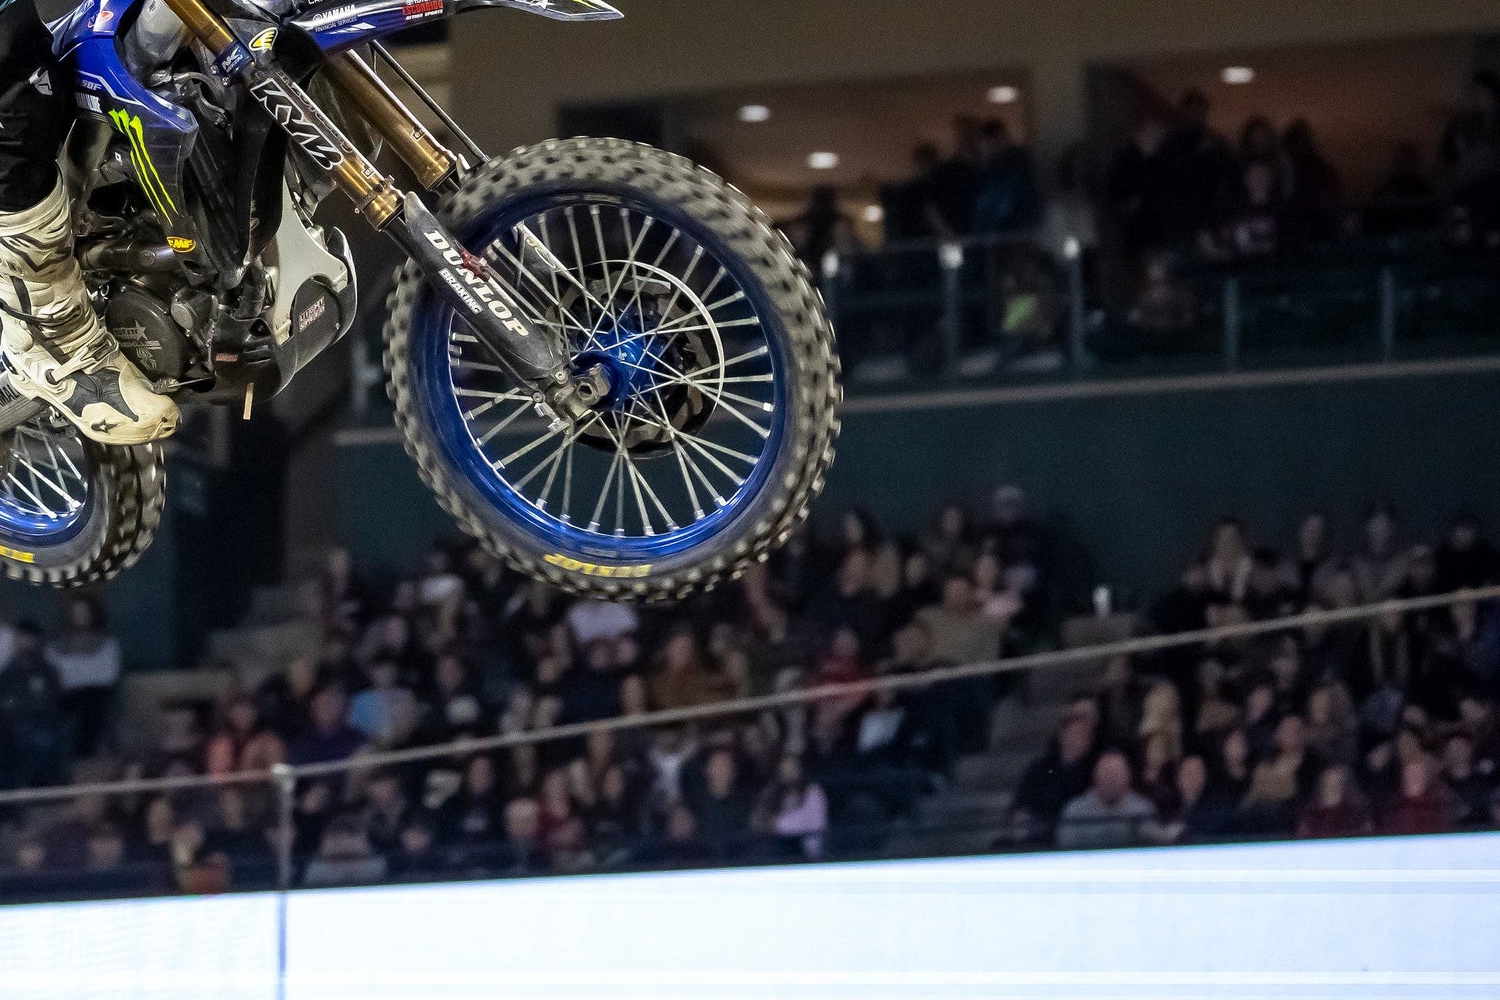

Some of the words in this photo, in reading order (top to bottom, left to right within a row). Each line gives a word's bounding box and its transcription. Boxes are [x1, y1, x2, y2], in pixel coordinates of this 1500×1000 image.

[322, 4, 357, 20] YAMAHA
[249, 77, 345, 171] KYB
[423, 229, 529, 337] DUNLOP
[439, 268, 482, 314] BRAKING
